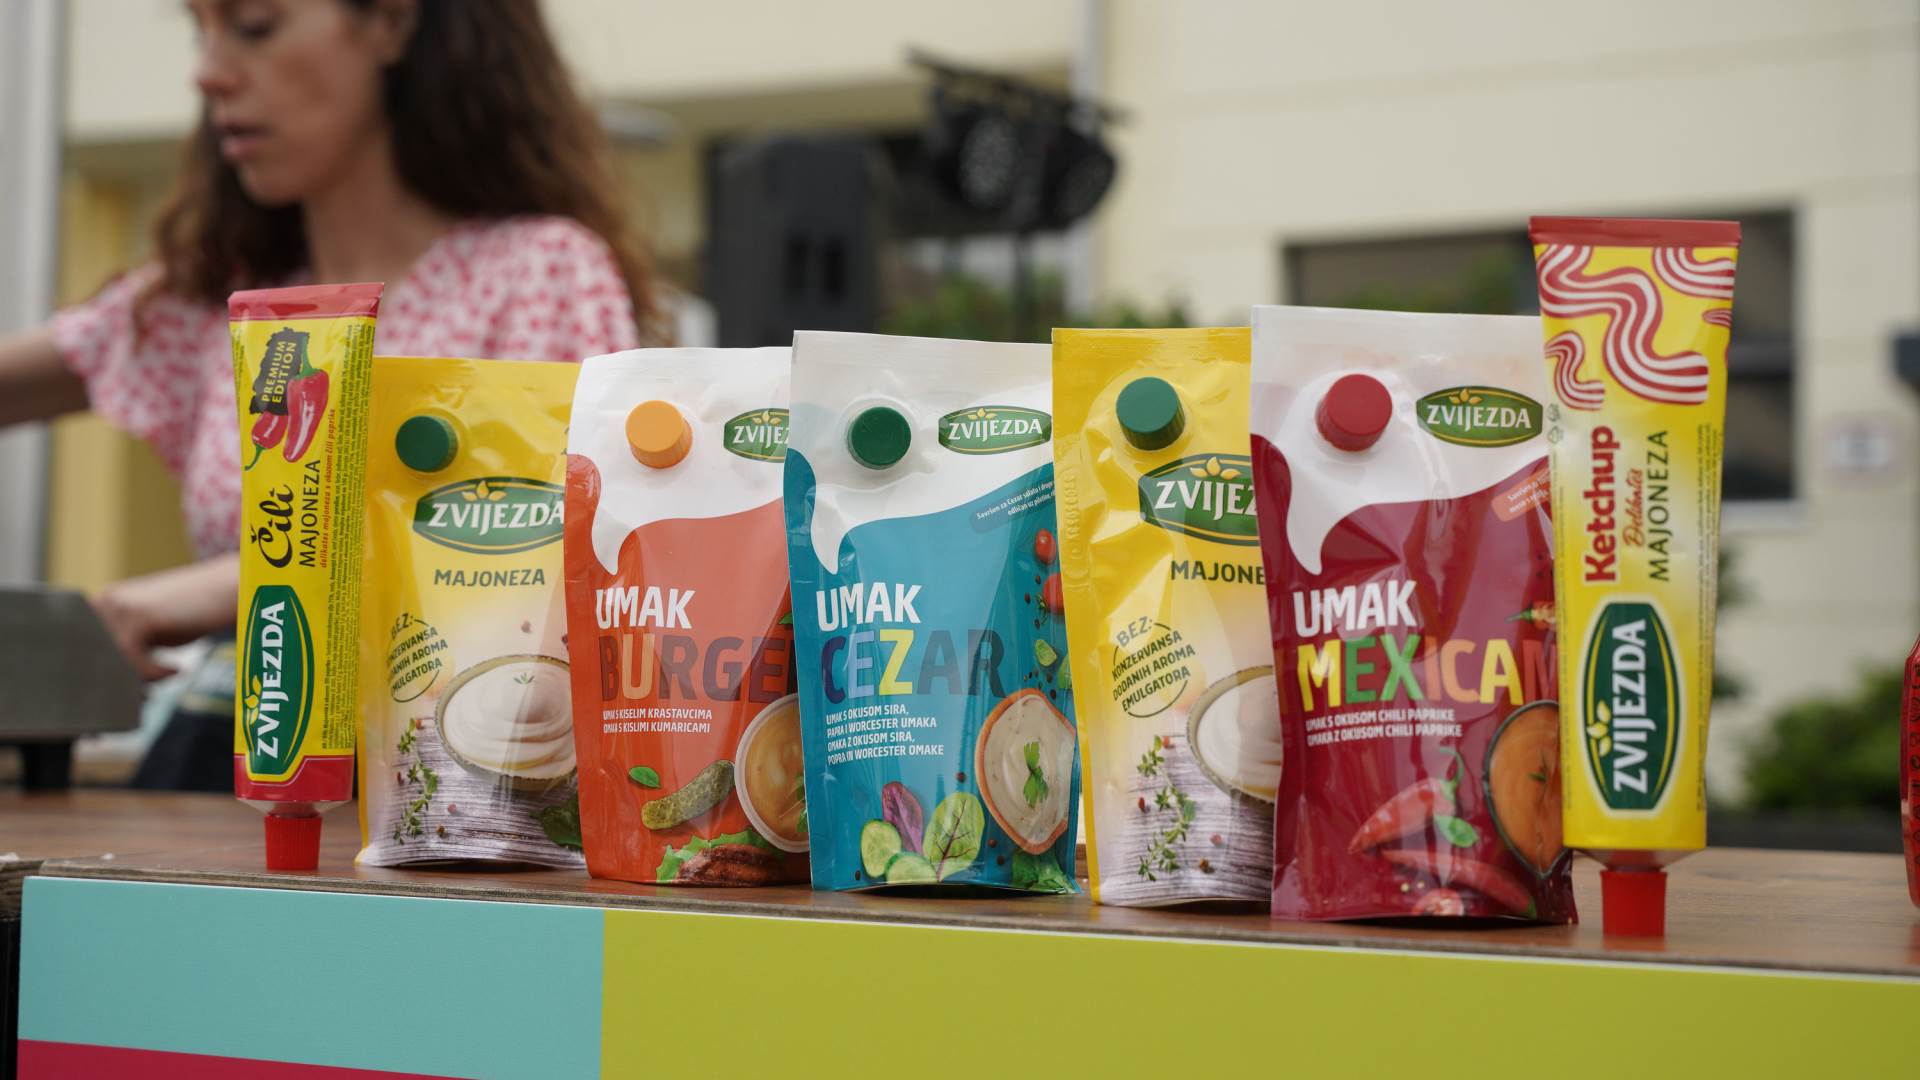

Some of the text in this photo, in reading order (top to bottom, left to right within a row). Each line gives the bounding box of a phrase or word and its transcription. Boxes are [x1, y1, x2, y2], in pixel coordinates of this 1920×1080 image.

[262, 341, 286, 402] PREMIUM
[272, 342, 296, 403] EDITION
[732, 425, 790, 448] ZVIJE
[948, 419, 1043, 442] ZVIJEZDA
[1426, 404, 1532, 432] ZVIJEZDA
[299, 460, 321, 567] MAJONEZA
[427, 502, 565, 536] ZVIJEZDA
[1584, 426, 1620, 582] Ketchup
[1648, 430, 1673, 582] MAJONEZA
[250, 484, 294, 568] Čili
[434, 568, 546, 586] MAJONEZA
[595, 586, 696, 629] UMAK
[816, 581, 922, 632] UMAK
[1293, 579, 1418, 638] UMAK
[412, 639, 448, 662] AROMA
[1117, 616, 1153, 648] BEZ:
[821, 629, 1007, 705] CEZAR
[1112, 630, 1183, 681] KONZERVANSA
[1113, 644, 1196, 701] DODANIH AROMA
[257, 601, 289, 759] ZVIJEZDA
[1122, 666, 1191, 712] EMULGATORA
[620, 708, 646, 719] KISELIM
[648, 708, 712, 720] KRASTAVCIMA
[826, 704, 909, 725] UMAK S OKUSOM SIRA,
[1327, 716, 1333, 727] S
[1335, 711, 1377, 726] OKUSOM
[1378, 709, 1406, 722] CHILI
[1408, 709, 1455, 721] PAPRIKE
[1612, 619, 1657, 794] ZVIJEZDA
[618, 723, 622, 732] S
[623, 722, 649, 732] KISLIMI
[650, 722, 710, 733] KUMARICAMI
[827, 725, 844, 738] PAPRA
[849, 718, 898, 733] WORCESTER
[901, 717, 937, 728] UMAKA
[828, 731, 915, 752] OMAKA Z OKUSOM SIRA,
[1334, 730, 1340, 742] Z
[1341, 725, 1384, 741] OKUSOM
[1385, 724, 1413, 737] CHILI
[1415, 724, 1463, 737] PAPRIKE
[847, 752, 854, 761] IN
[855, 745, 906, 760] WORCESTER
[909, 744, 944, 755] OMAKE
